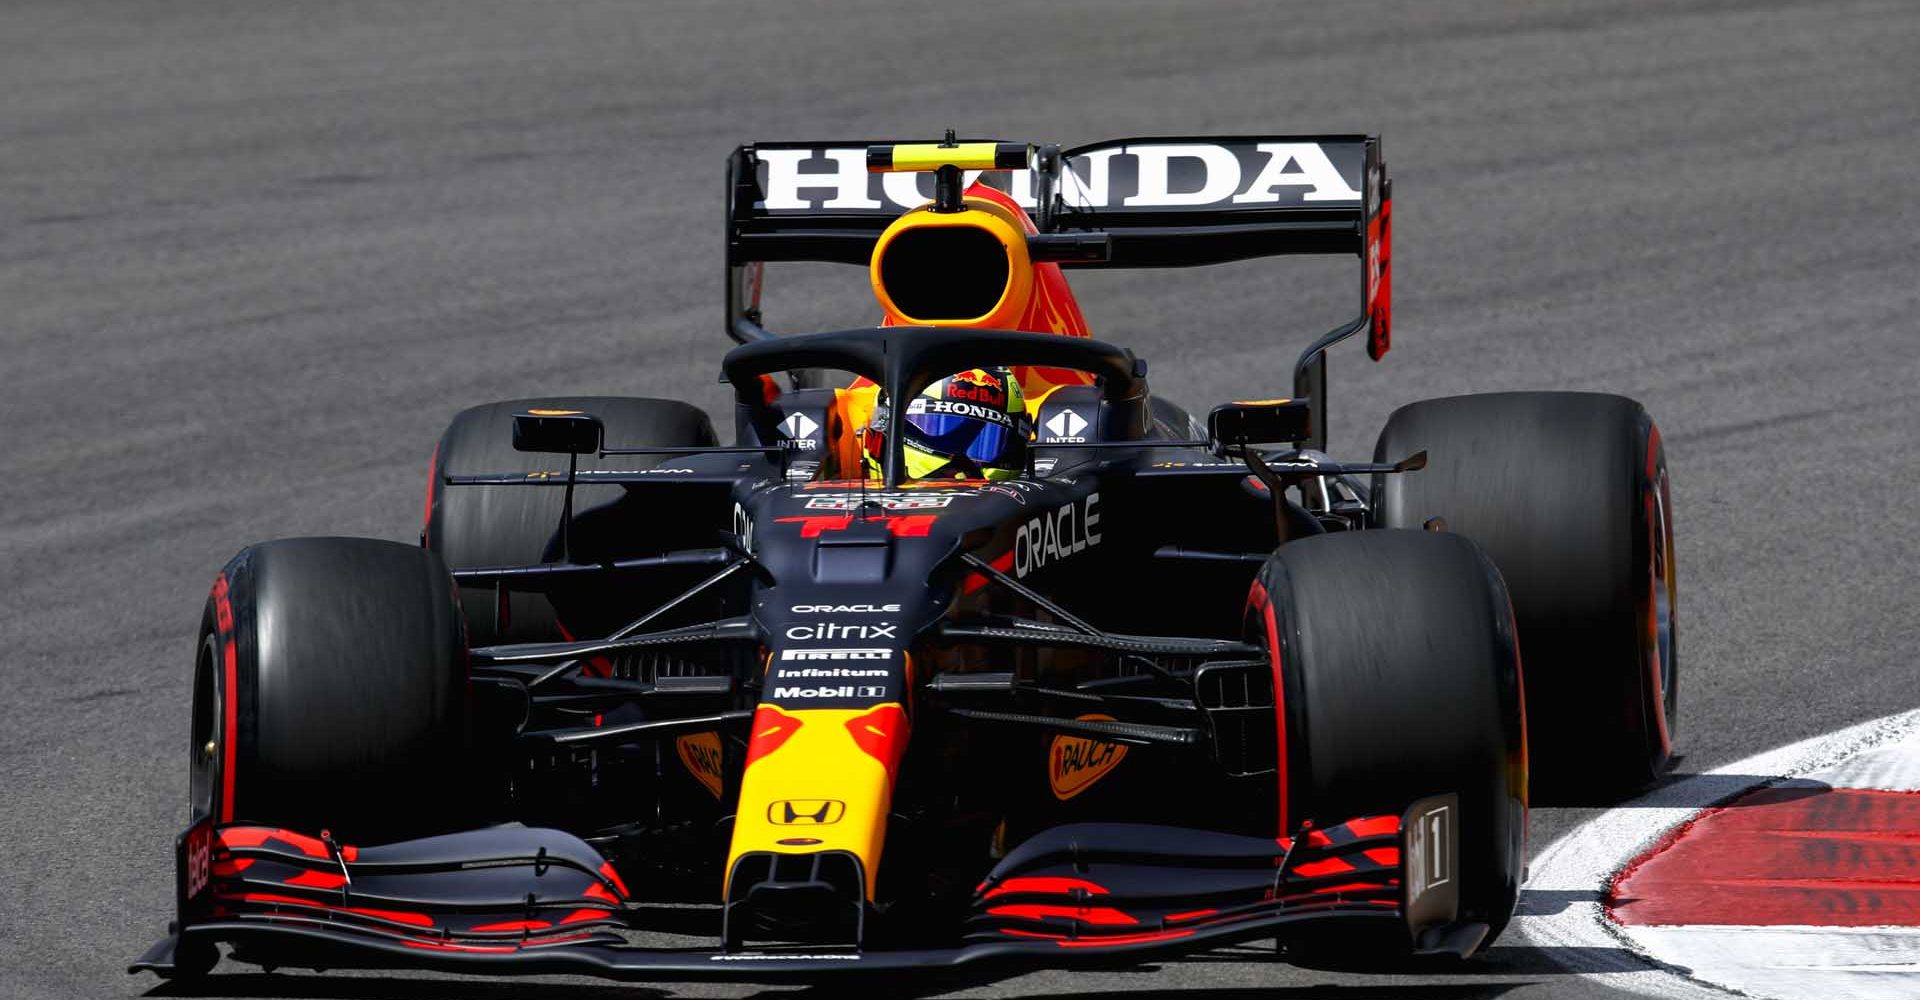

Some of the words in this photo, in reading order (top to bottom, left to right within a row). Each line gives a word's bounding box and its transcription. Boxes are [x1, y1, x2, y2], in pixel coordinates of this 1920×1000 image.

[947, 382, 977, 400] Red
[980, 387, 1006, 407] Bull
[933, 401, 1014, 428] HONDA
[777, 439, 817, 449] INTER
[1015, 493, 1102, 579] ORACLE
[791, 604, 902, 613] ORACLE
[786, 621, 898, 640] citrix
[781, 648, 893, 661] PIRELLI
[774, 686, 854, 699] Mobil
[1061, 740, 1117, 777] RAUCH
